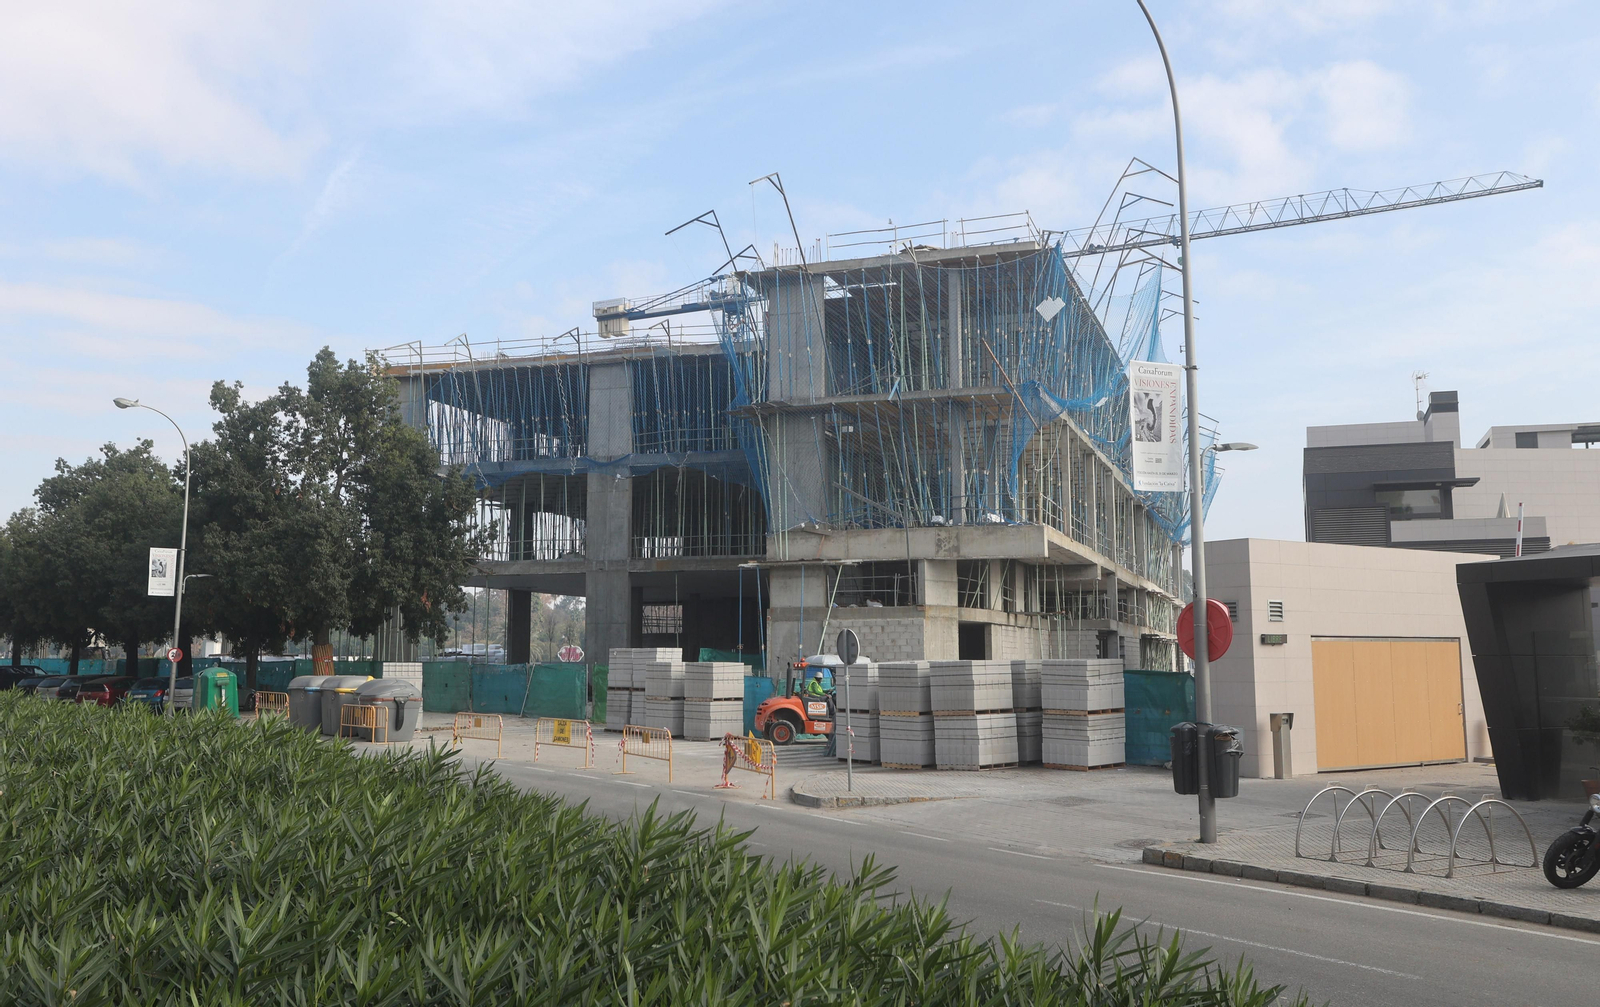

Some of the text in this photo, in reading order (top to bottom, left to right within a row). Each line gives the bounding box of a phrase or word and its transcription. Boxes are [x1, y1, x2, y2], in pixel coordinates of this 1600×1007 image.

[1138, 366, 1173, 376] CaixaForum
[1134, 379, 1170, 389] VISIONES
[1267, 635, 1282, 643] LIBRE
